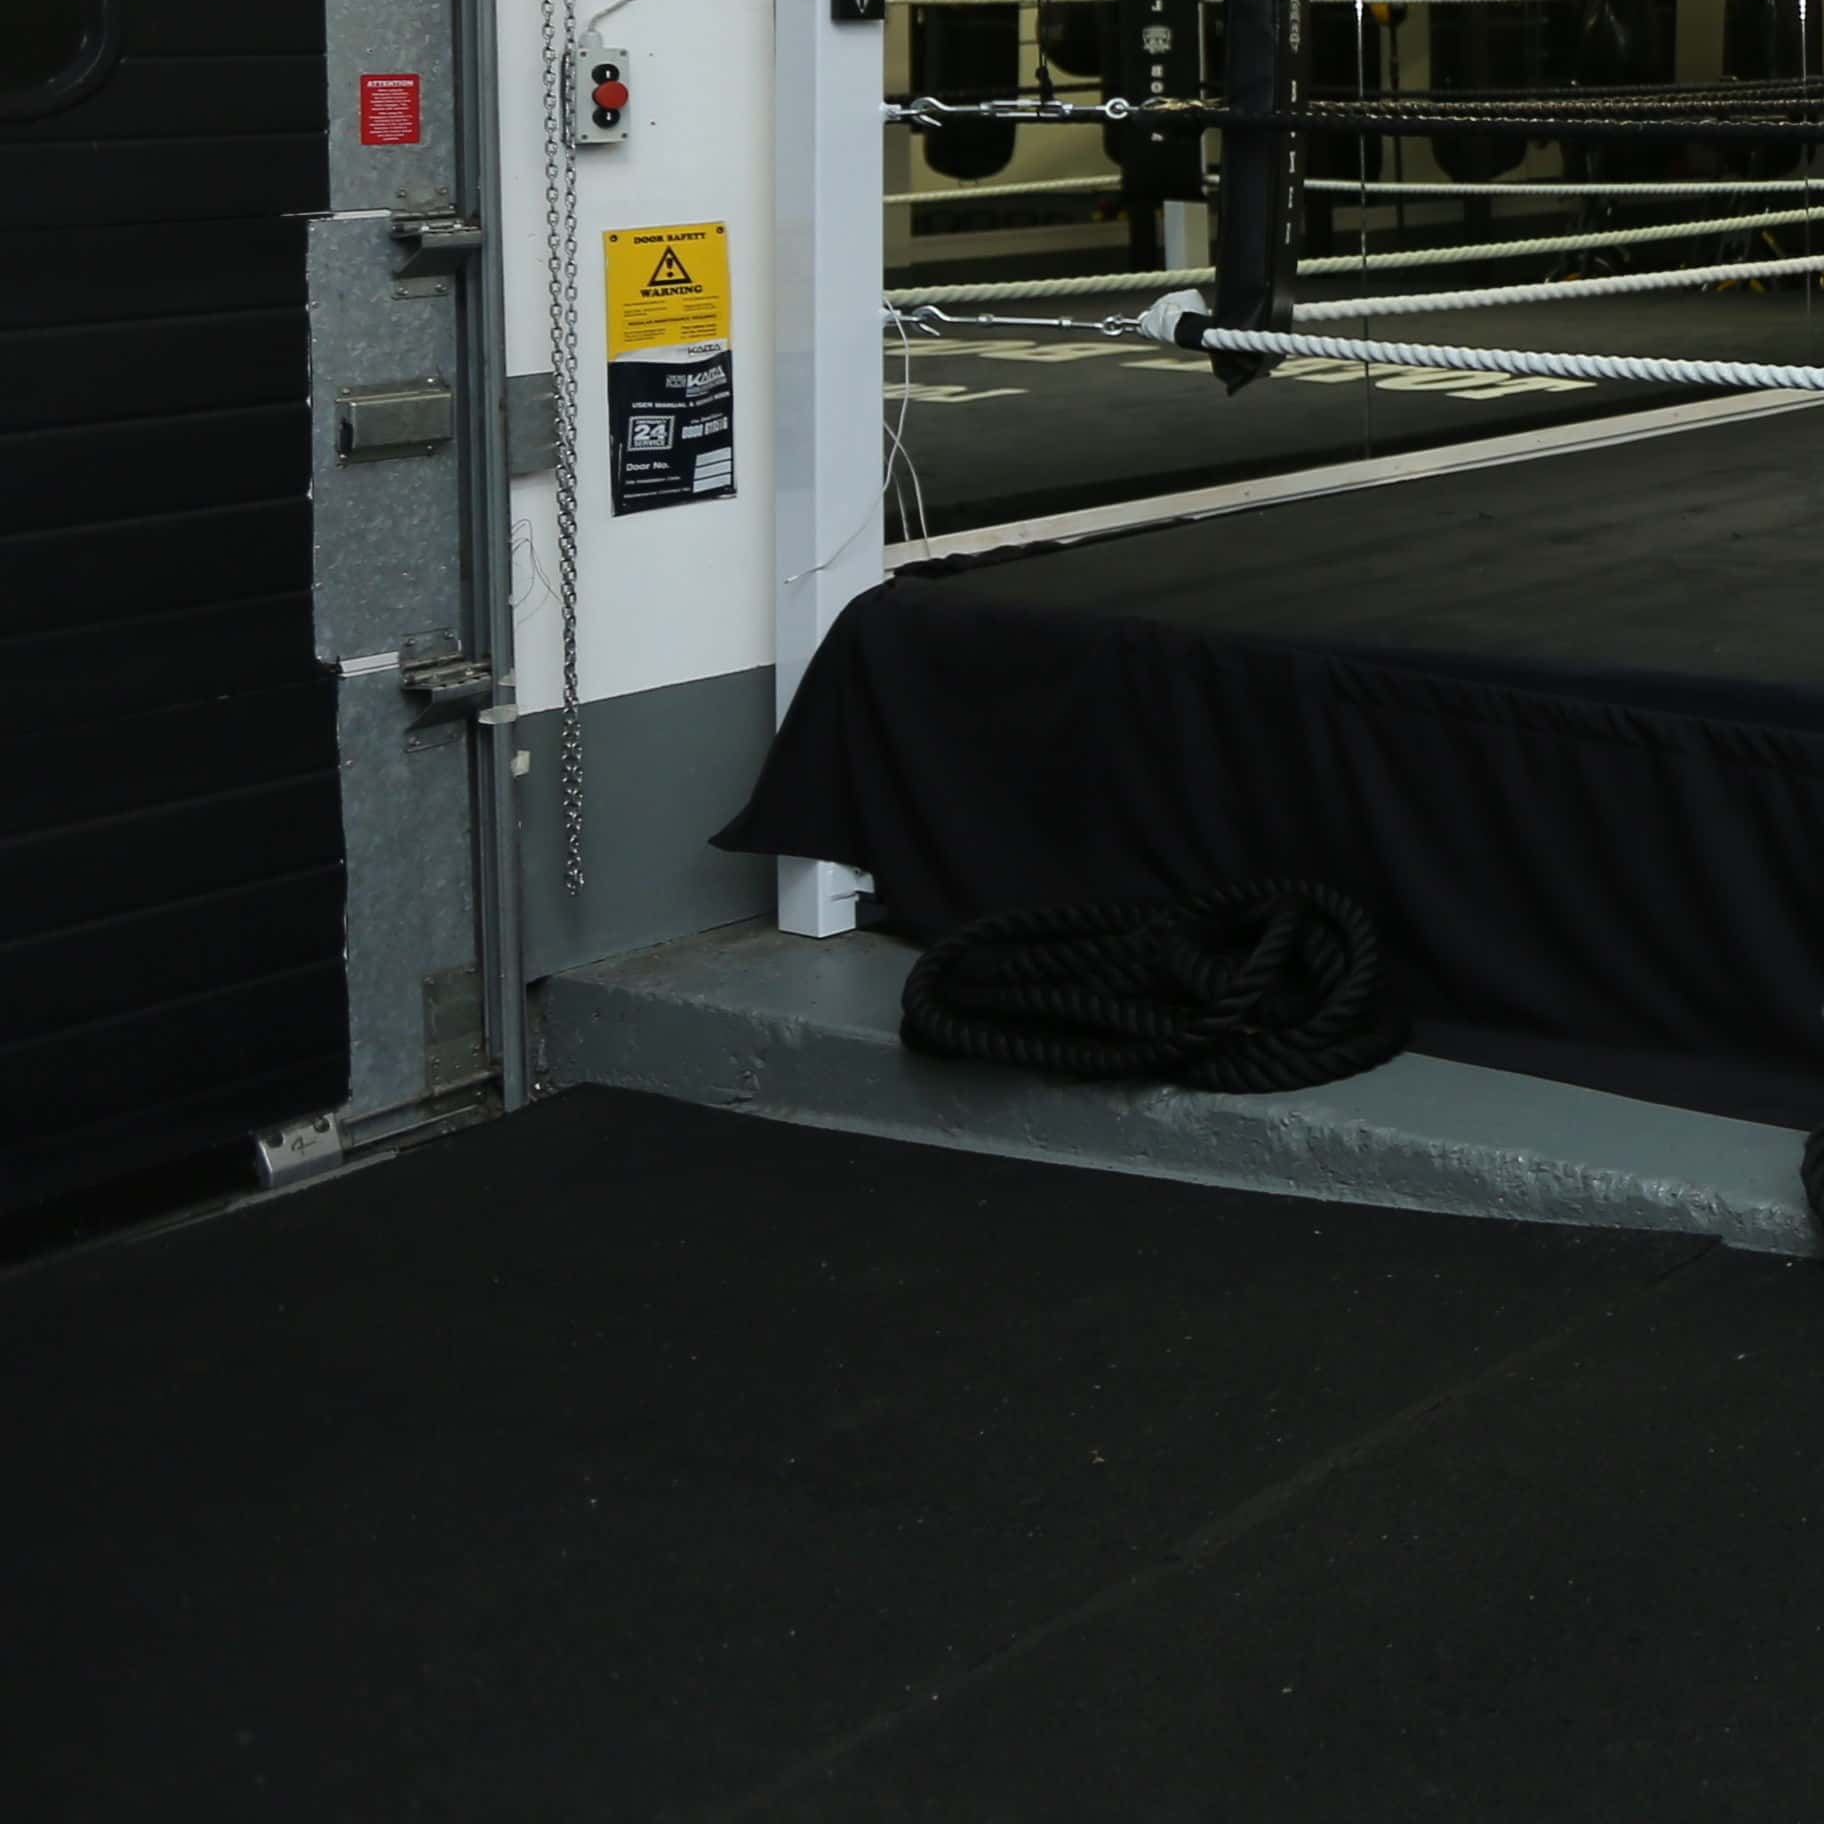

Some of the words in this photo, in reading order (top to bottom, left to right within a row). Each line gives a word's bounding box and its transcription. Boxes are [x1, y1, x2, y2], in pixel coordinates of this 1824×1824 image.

[634, 234, 664, 245] DOOR
[667, 232, 706, 242] SAFETY
[640, 284, 703, 298] WARNING
[633, 424, 668, 440] 24
[626, 463, 650, 472] Door
